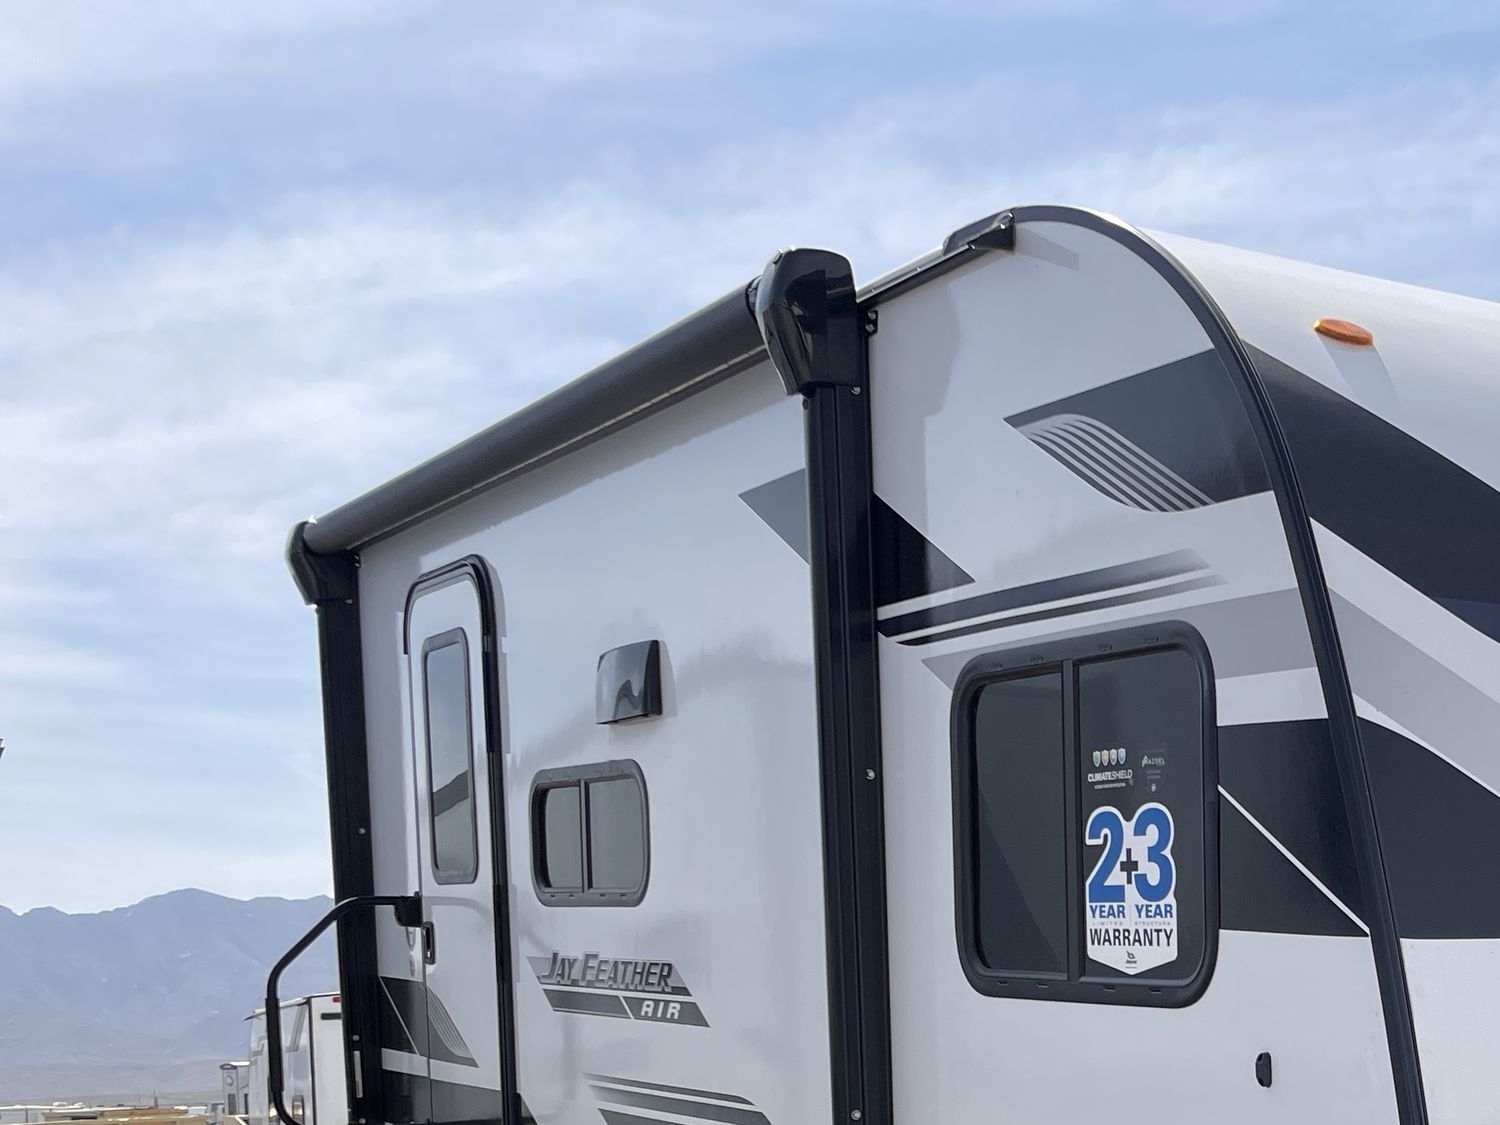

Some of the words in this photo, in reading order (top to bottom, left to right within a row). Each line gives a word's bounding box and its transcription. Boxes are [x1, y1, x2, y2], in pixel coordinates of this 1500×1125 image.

[1089, 904, 1126, 919] YEAR
[1135, 904, 1173, 919] YEAR
[1089, 928, 1174, 947] WARRANTY
[581, 953, 673, 990] FEATHER
[640, 1000, 681, 1019] AIR
